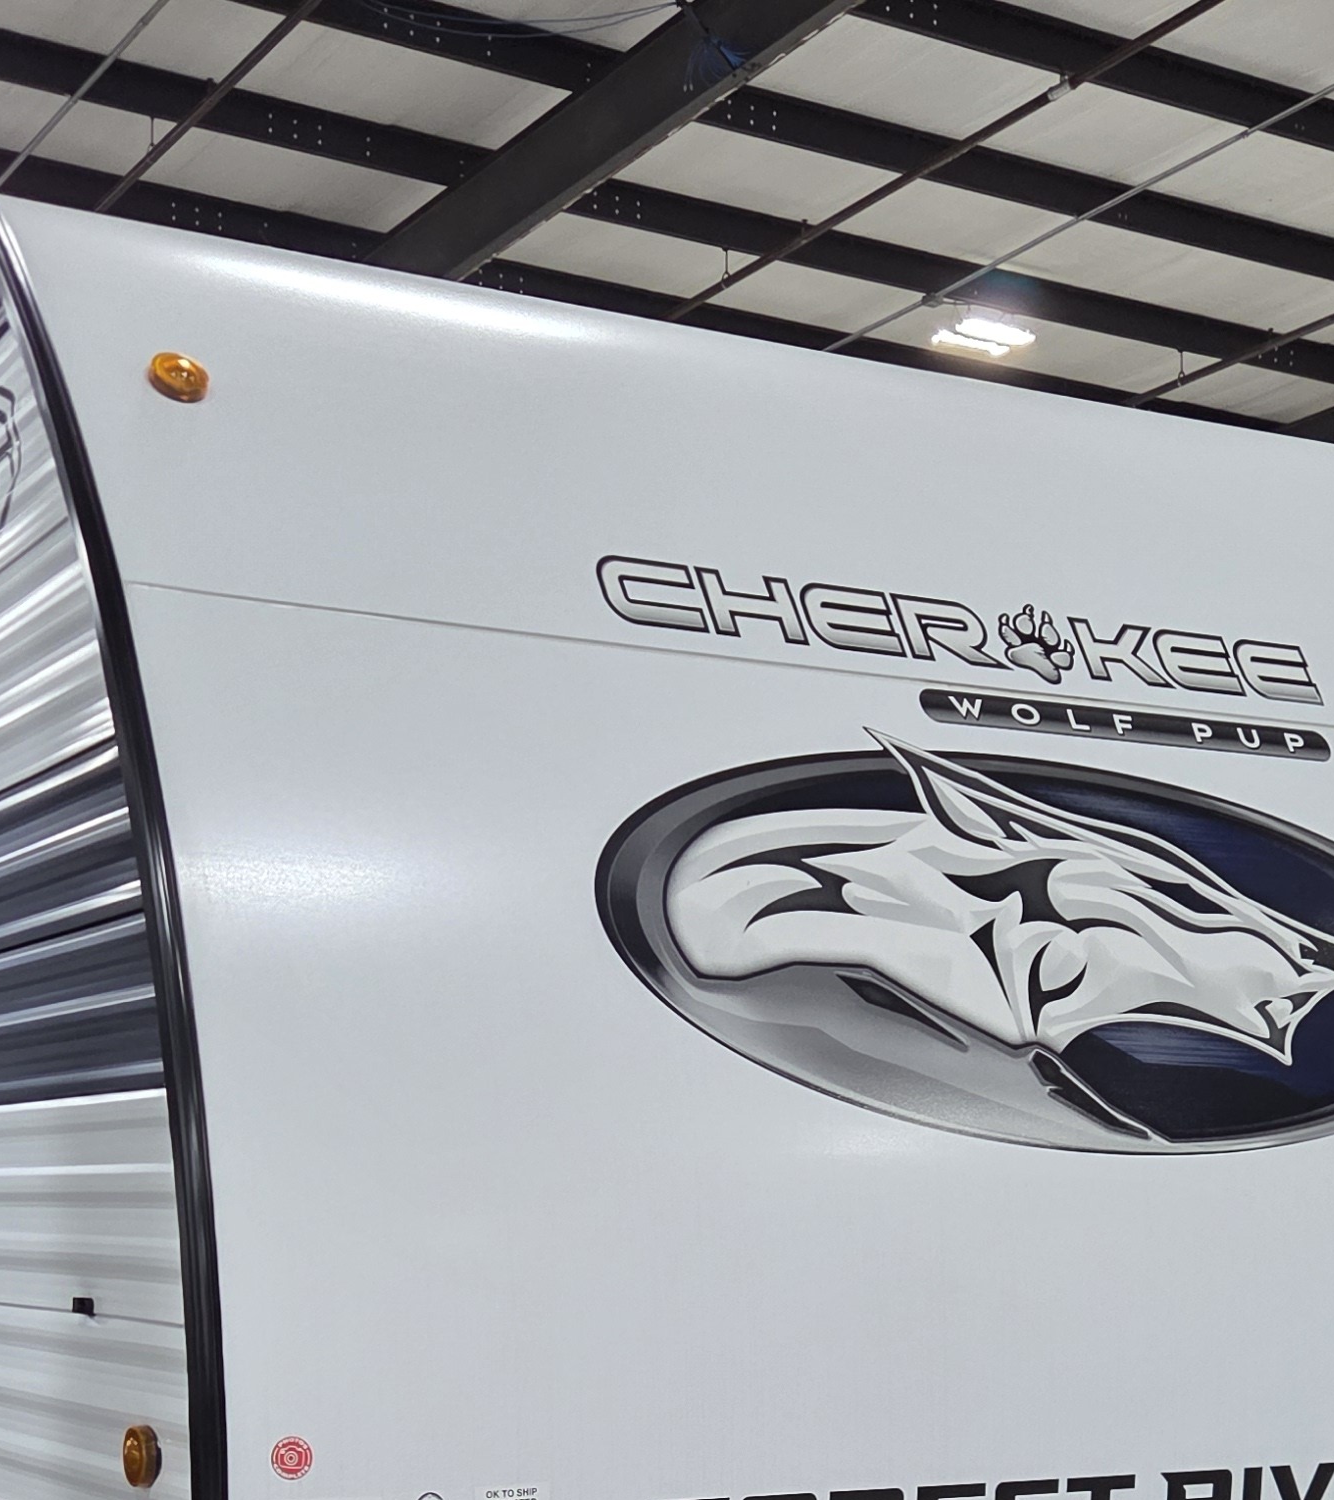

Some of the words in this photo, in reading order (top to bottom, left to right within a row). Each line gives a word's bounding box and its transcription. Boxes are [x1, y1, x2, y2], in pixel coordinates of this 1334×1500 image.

[948, 696, 1134, 737] WOLF
[1192, 721, 1308, 754] PUP
[485, 1490, 500, 1499] OK
[502, 1489, 515, 1498] TO
[516, 1488, 538, 1497] SHIP
